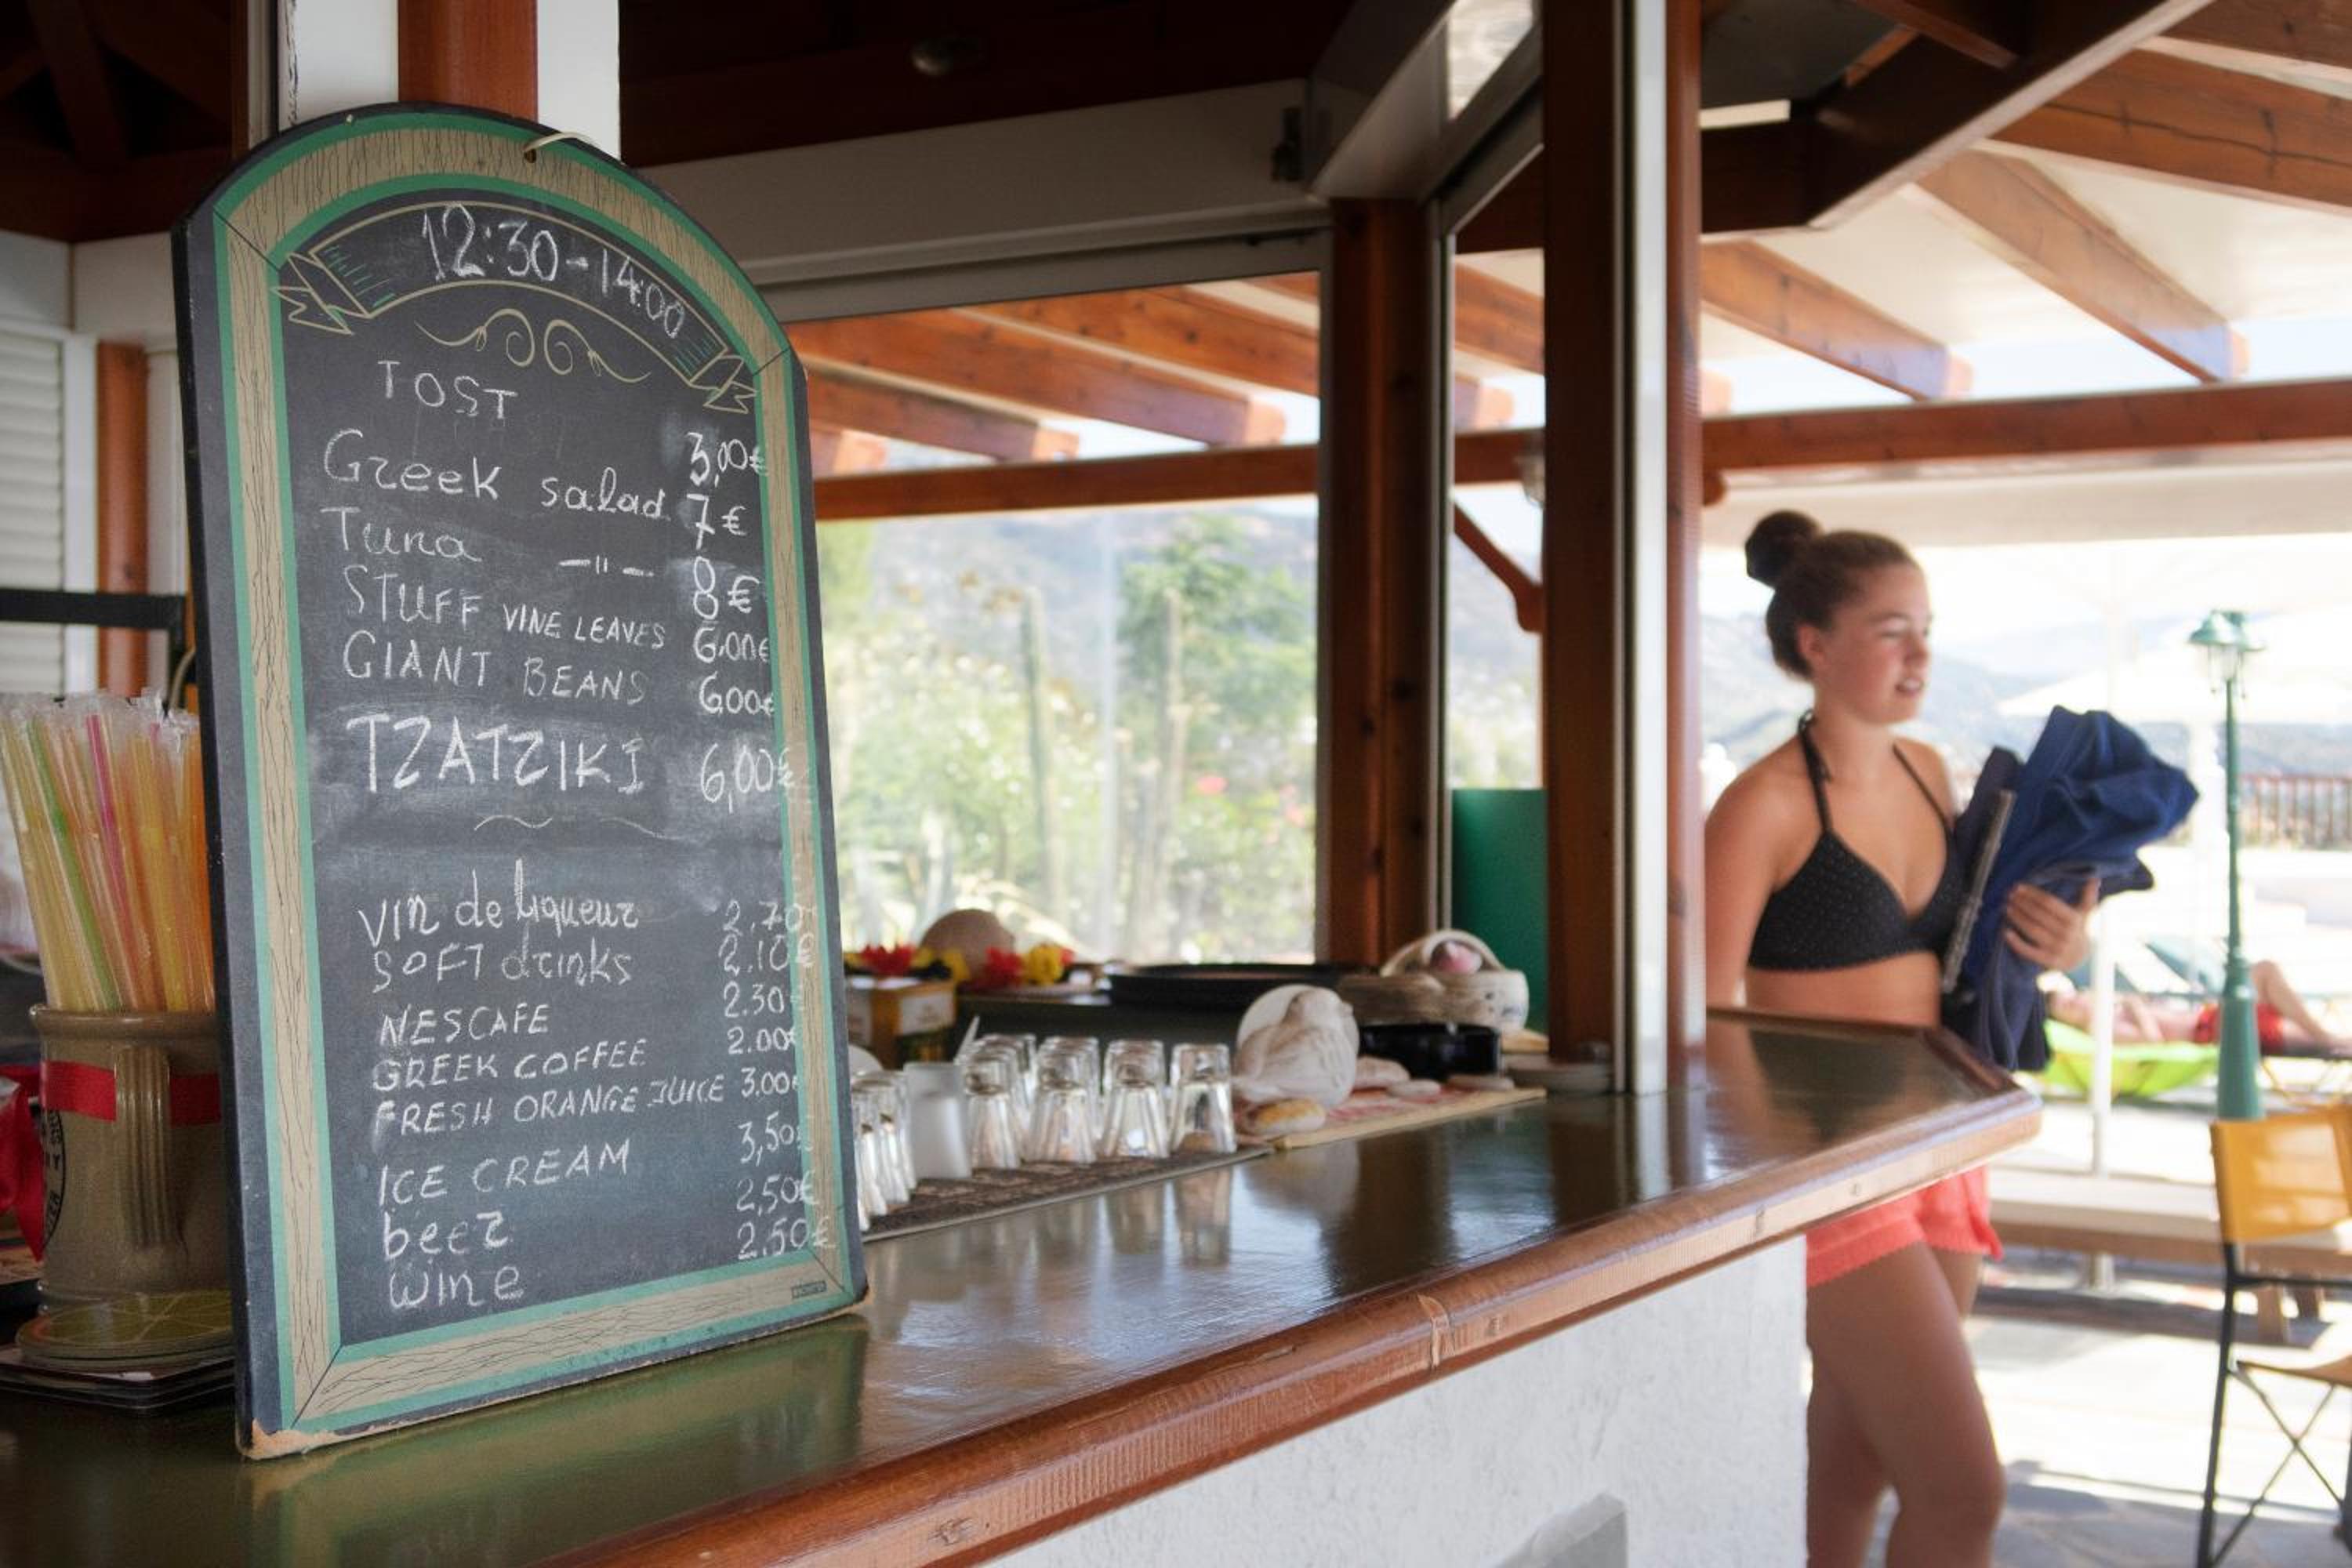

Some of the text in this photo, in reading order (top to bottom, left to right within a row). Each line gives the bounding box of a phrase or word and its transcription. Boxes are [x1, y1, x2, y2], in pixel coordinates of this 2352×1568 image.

[379, 360, 518, 420] TOST
[323, 428, 500, 500] Greek
[540, 467, 666, 518] salad
[320, 506, 483, 562] Tuna
[343, 564, 482, 630] STUFF
[503, 603, 562, 640] VINE
[575, 615, 666, 650] LEAVES
[343, 630, 492, 687] GIANT
[524, 657, 648, 705] BEANS
[454, 868, 503, 928] de
[501, 922, 632, 986] drinks
[379, 1003, 549, 1047] NESCAFE
[372, 1053, 498, 1091] GREEK
[514, 1038, 647, 1080] COFFEE
[375, 1098, 493, 1137] FRESH
[514, 1083, 639, 1123] ORANGE
[647, 1073, 725, 1105] JUICE
[379, 1163, 448, 1207] ICE
[472, 1138, 630, 1192] CREAM
[383, 1211, 511, 1260] beer
